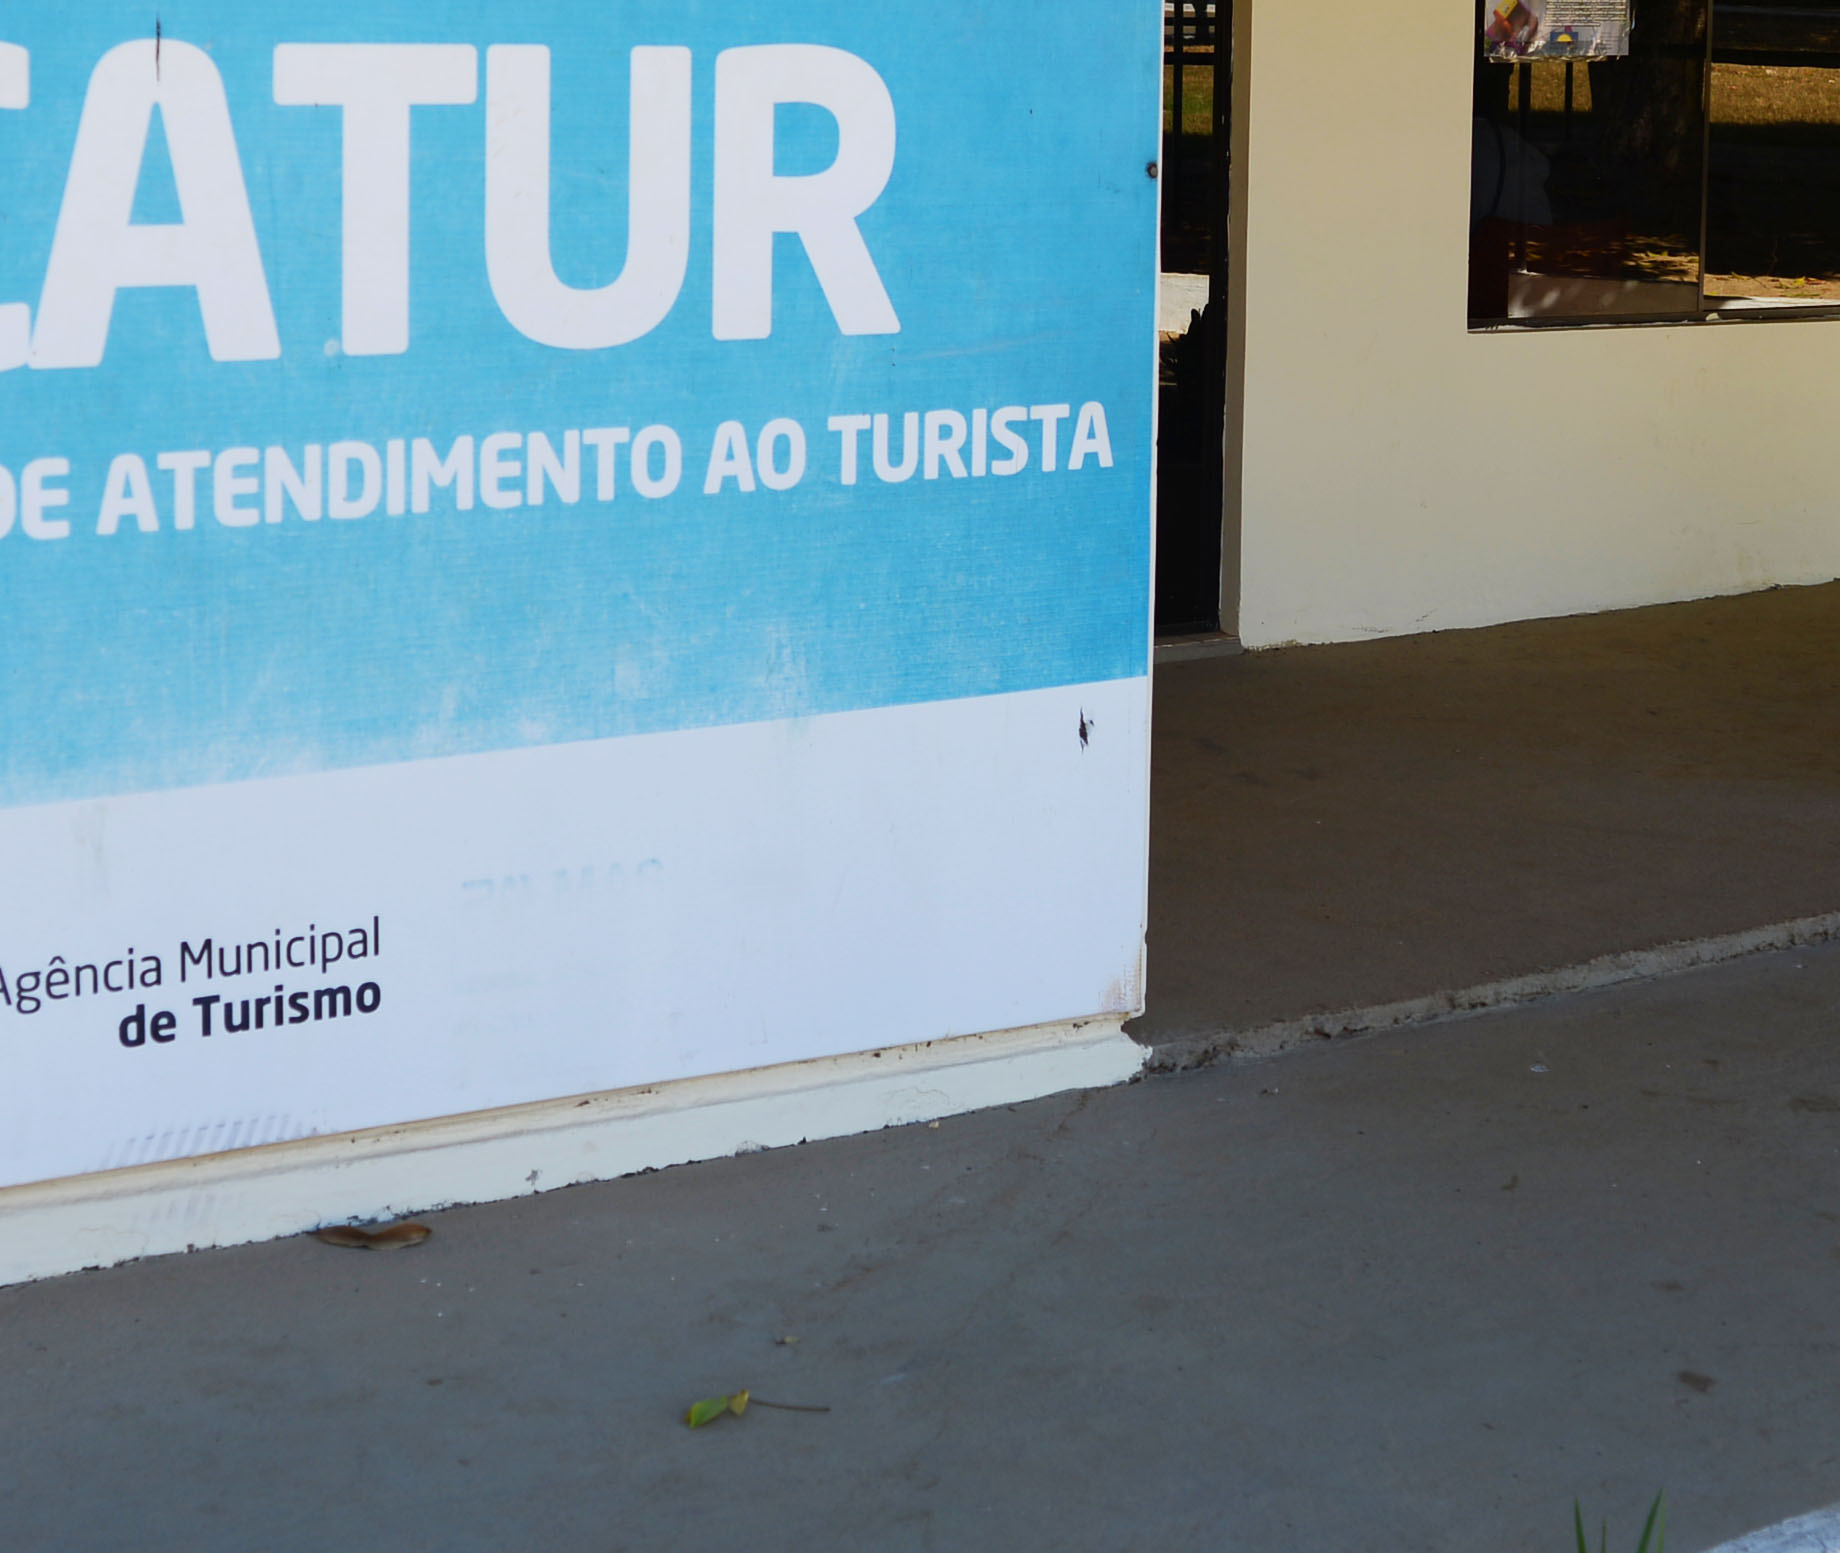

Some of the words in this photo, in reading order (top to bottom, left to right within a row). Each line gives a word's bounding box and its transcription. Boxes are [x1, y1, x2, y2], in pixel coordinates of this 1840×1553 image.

[95, 423, 683, 536] ATENDIMENTO
[703, 417, 807, 495] AO
[827, 401, 1114, 486] TURISTA
[180, 915, 381, 983] Municipal
[118, 1003, 177, 1048] de
[192, 981, 382, 1038] Turismo
